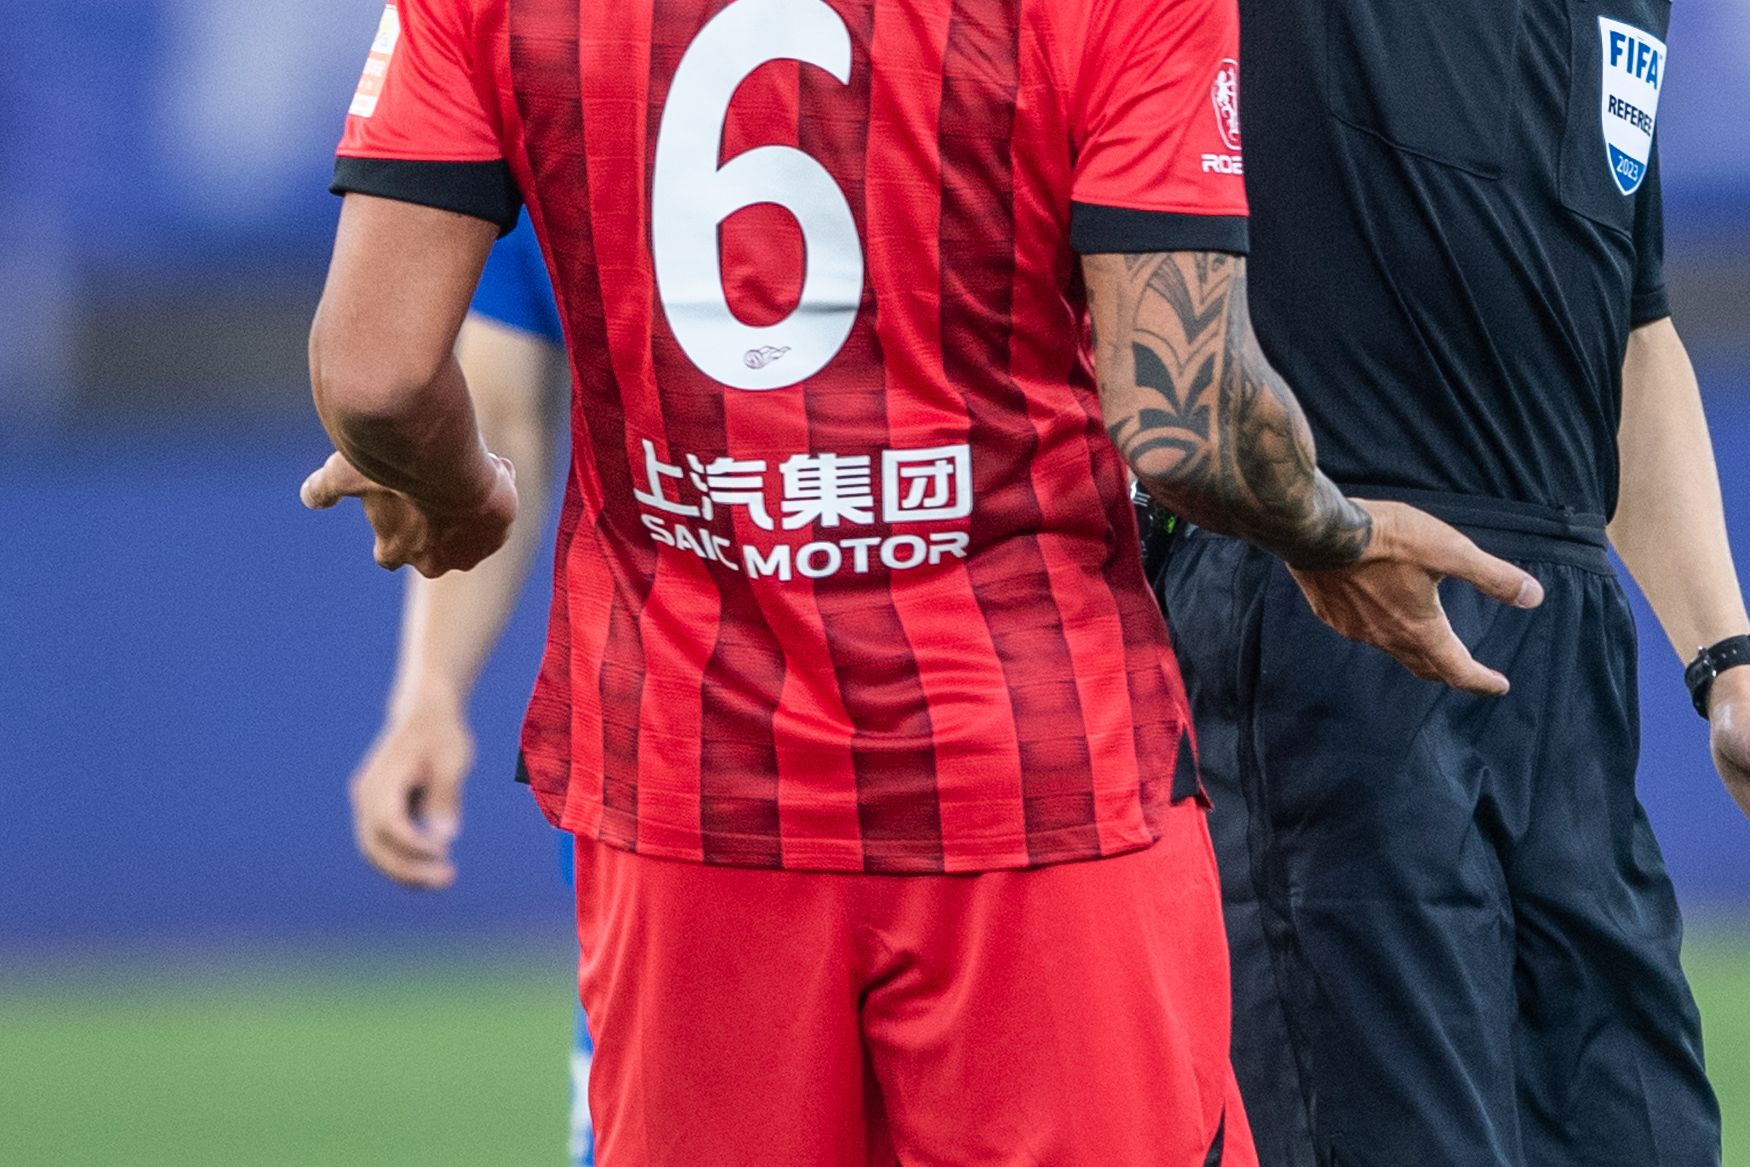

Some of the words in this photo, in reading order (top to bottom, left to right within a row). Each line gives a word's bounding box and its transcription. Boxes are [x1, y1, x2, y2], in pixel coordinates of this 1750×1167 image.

[1609, 29, 1658, 91] FIFA
[1608, 94, 1653, 137] REFEREE
[1616, 155, 1640, 182] 2023
[634, 438, 973, 531] 上汽集团
[641, 514, 739, 571] SAIC
[743, 531, 970, 581] MOTOR
